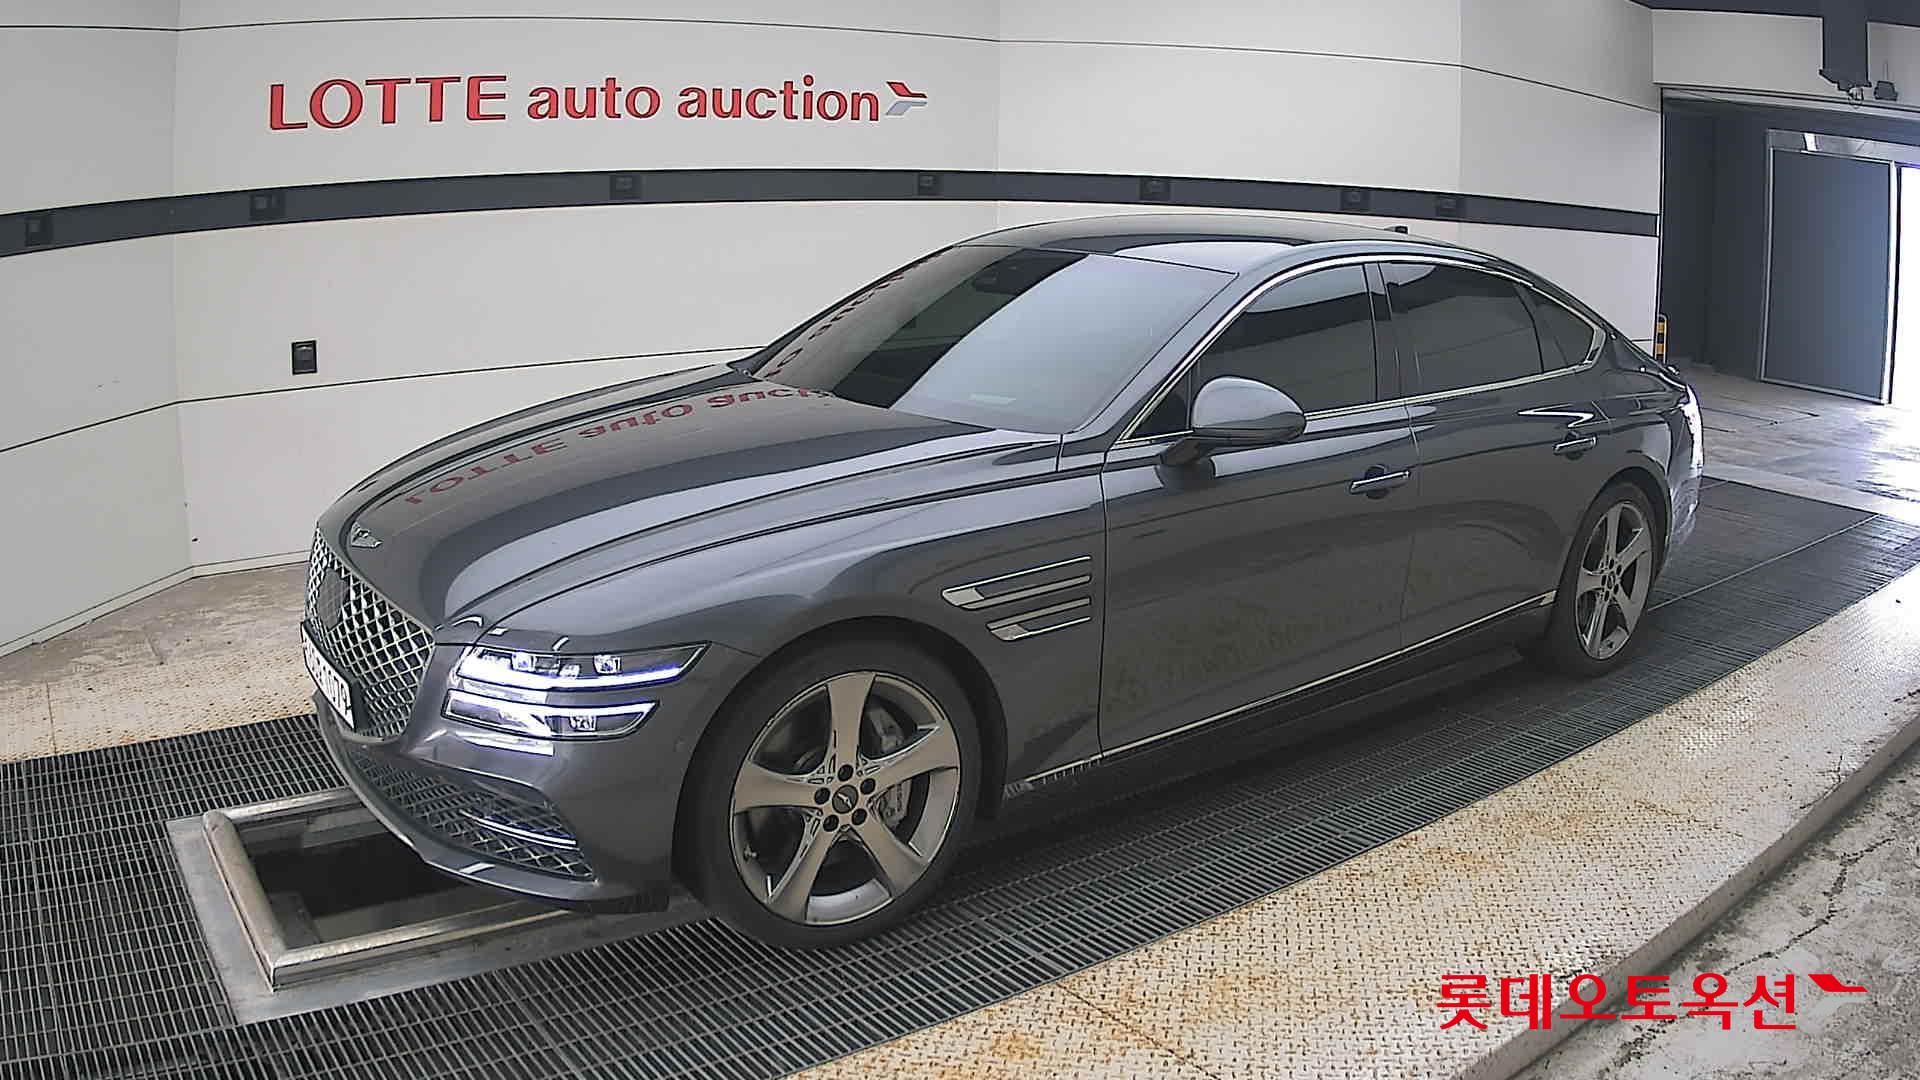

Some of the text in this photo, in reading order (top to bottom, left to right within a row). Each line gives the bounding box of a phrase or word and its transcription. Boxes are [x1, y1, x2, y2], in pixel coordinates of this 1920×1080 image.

[268, 74, 880, 130] LOTTE auto auction
